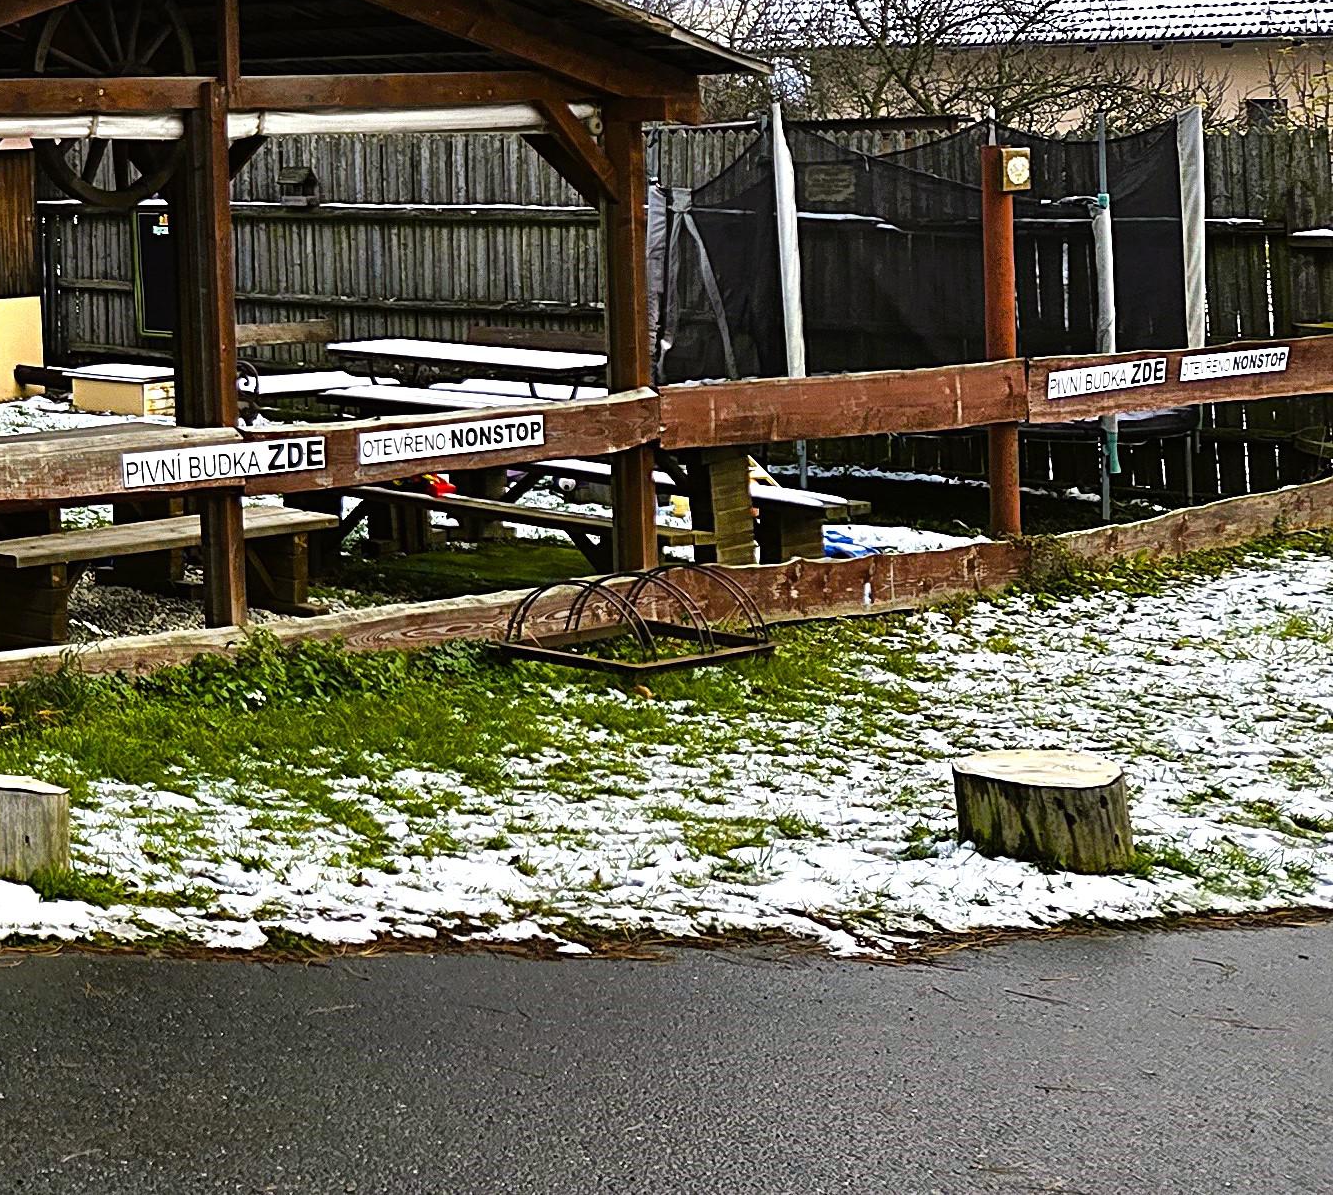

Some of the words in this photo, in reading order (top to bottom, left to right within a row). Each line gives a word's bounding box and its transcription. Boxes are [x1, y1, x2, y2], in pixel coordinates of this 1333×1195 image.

[1050, 373, 1083, 395] PIVNÍ
[1085, 370, 1127, 391] BUDKA
[1130, 360, 1165, 384] ZDE
[1232, 352, 1286, 371] NONSTOP
[362, 431, 445, 457] OTEVŘENO
[450, 421, 542, 448] NONSTOP
[126, 457, 182, 484] PIVNÍ
[189, 451, 261, 479] BUDKA
[267, 439, 324, 471] ZDE
